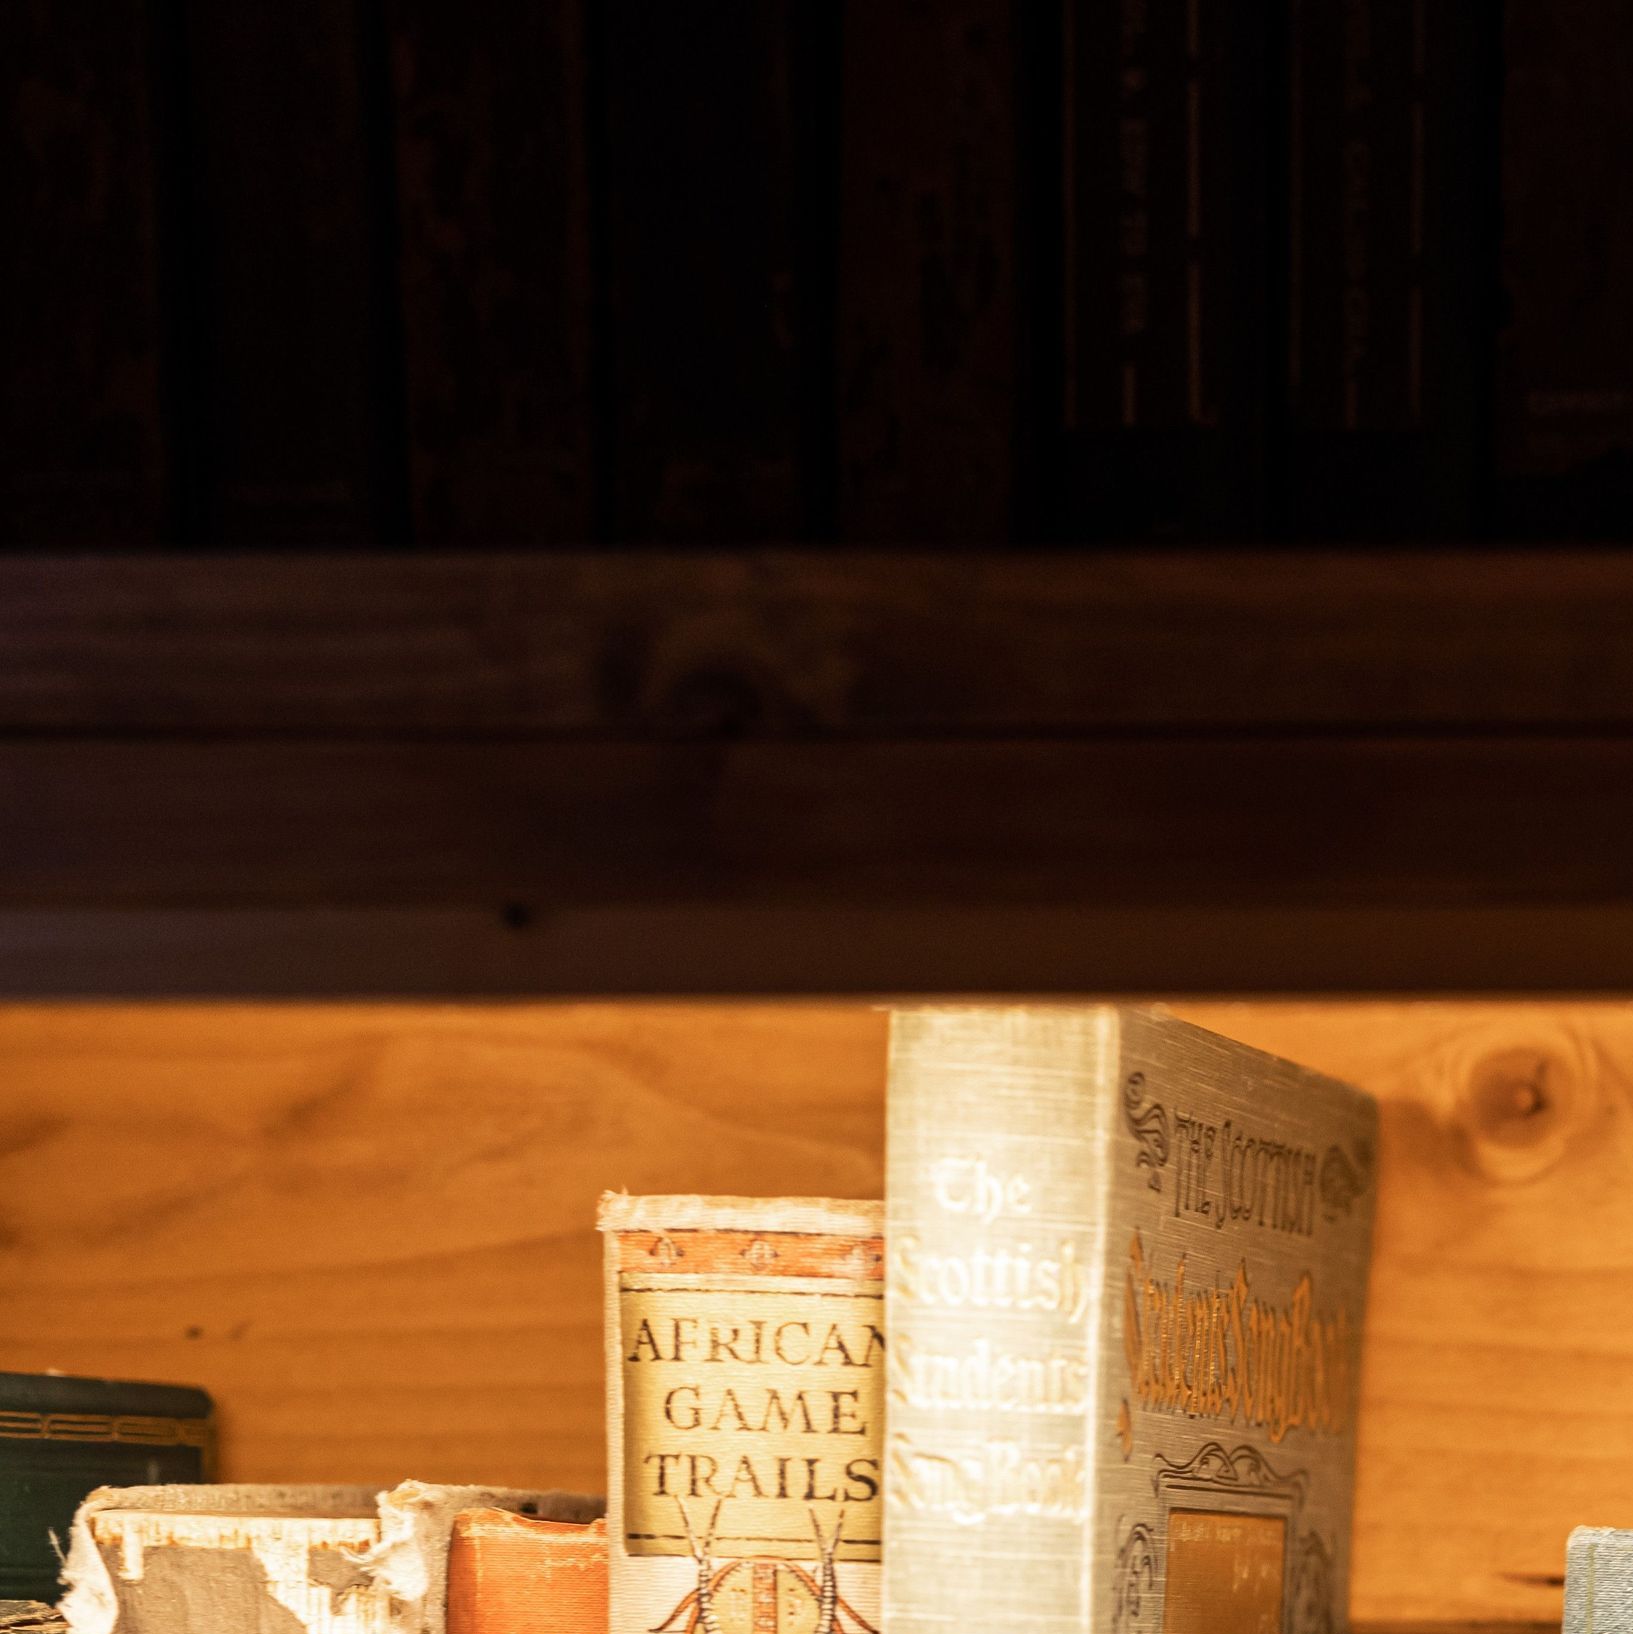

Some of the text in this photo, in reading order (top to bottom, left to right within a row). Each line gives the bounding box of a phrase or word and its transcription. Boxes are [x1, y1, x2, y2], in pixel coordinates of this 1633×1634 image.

[933, 1156, 1034, 1224] The
[897, 1234, 1088, 1324] Scottish
[664, 1386, 866, 1435] GAME
[644, 1453, 880, 1502] TRAILS
